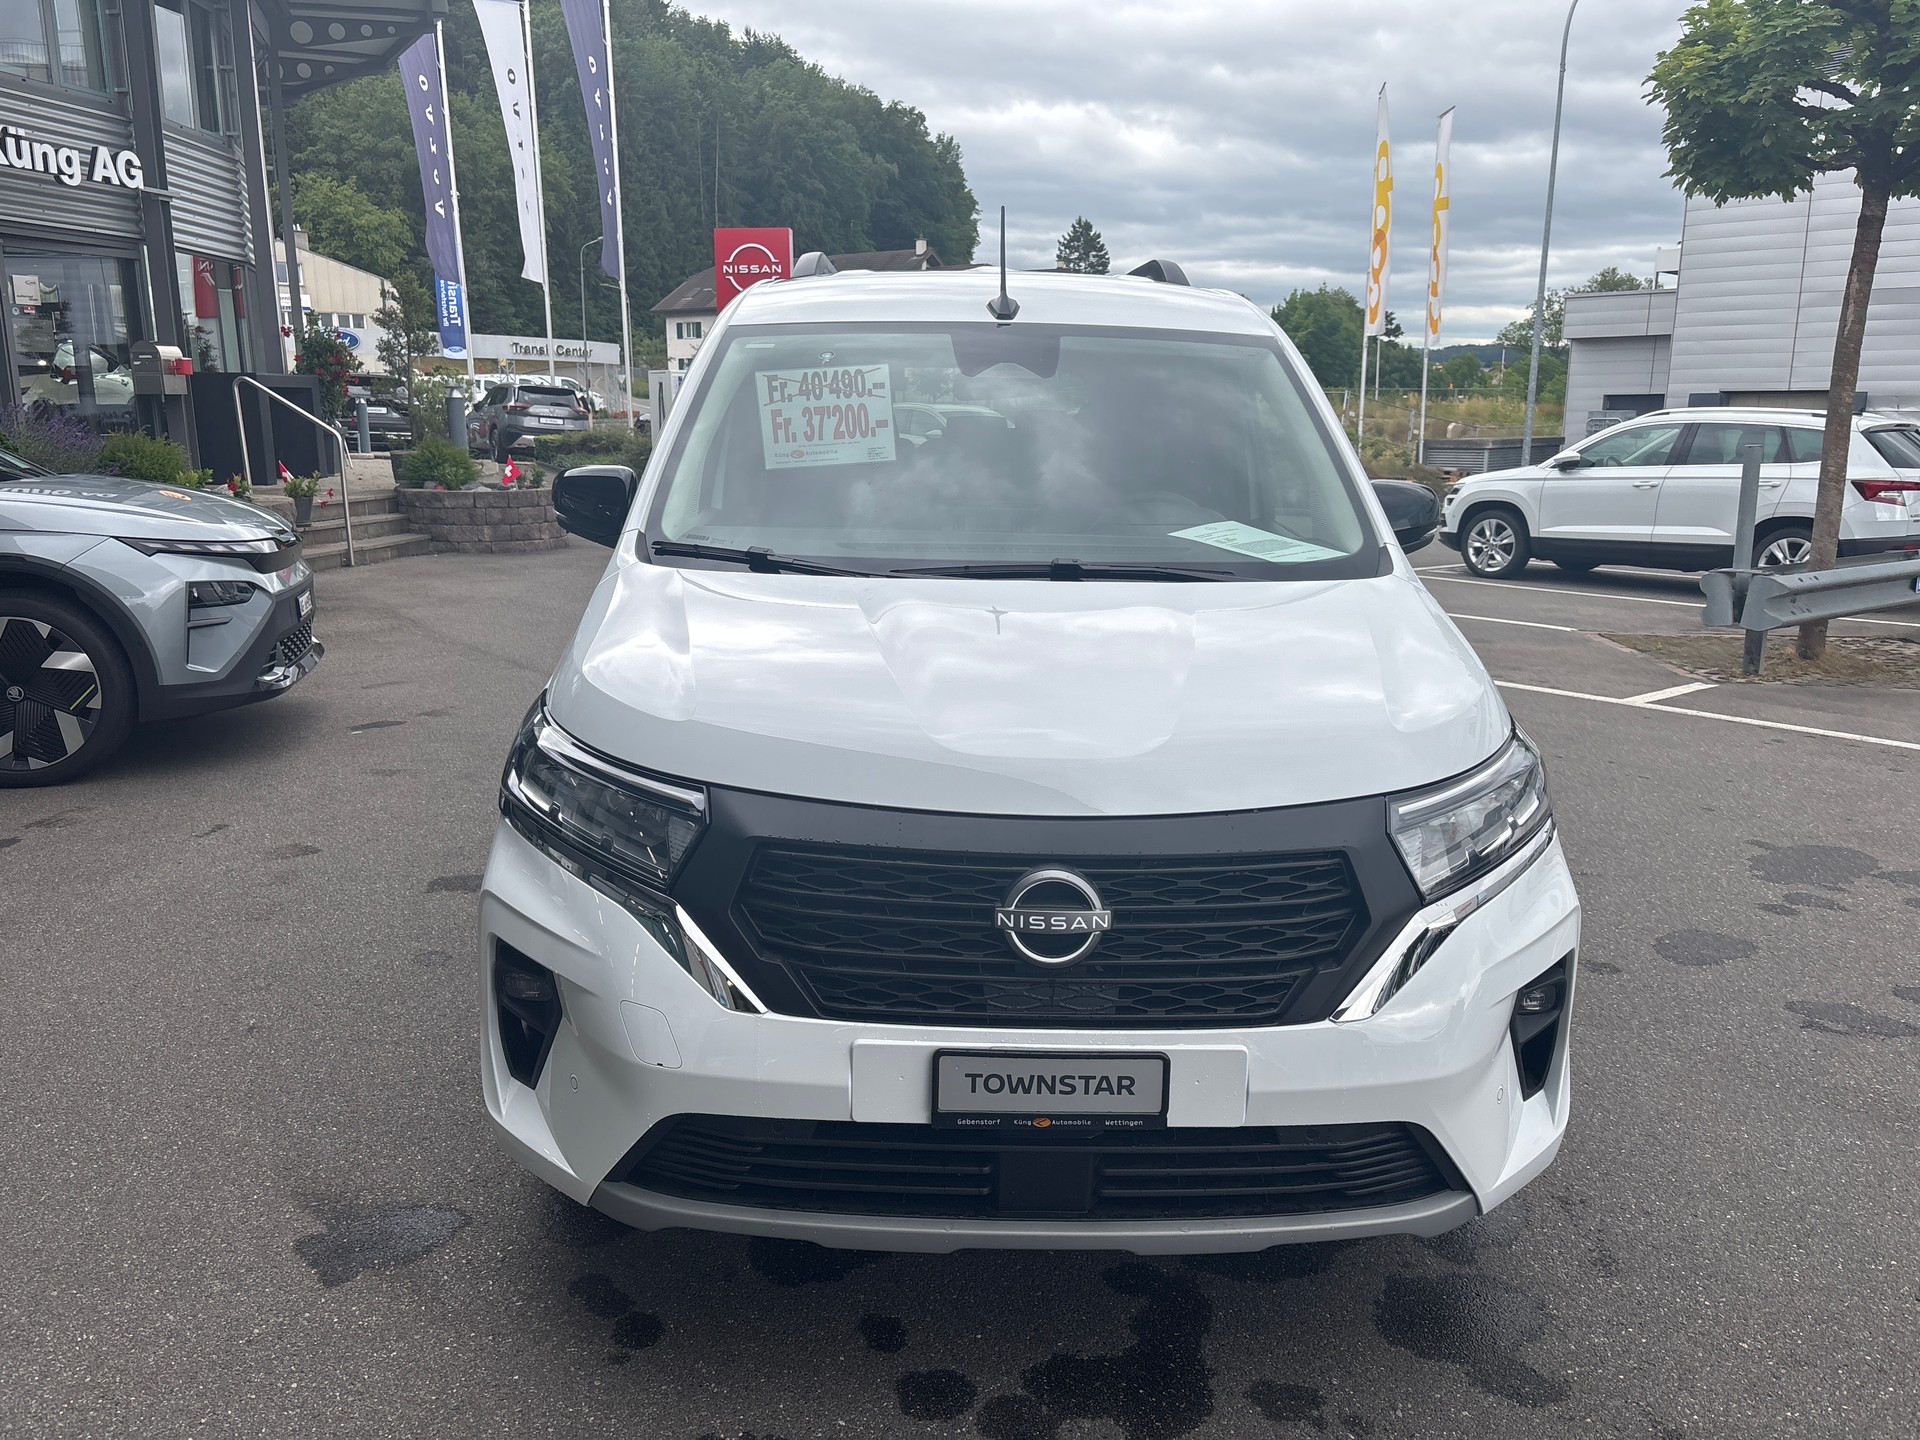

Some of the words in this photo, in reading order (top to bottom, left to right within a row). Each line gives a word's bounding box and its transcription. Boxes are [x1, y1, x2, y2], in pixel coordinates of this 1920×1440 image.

[92, 145, 144, 189] AG
[722, 264, 782, 274] NISSAN
[511, 342, 549, 357] Transi
[767, 374, 793, 403] Fr.
[771, 409, 797, 444] Fr.
[997, 912, 1109, 930] NISSAN
[965, 1073, 1136, 1096] TOWNSTAR
[957, 1118, 1001, 1126] Gebenstorf
[1013, 1118, 1032, 1127] Küng
[1105, 1119, 1144, 1127] Wettingen
